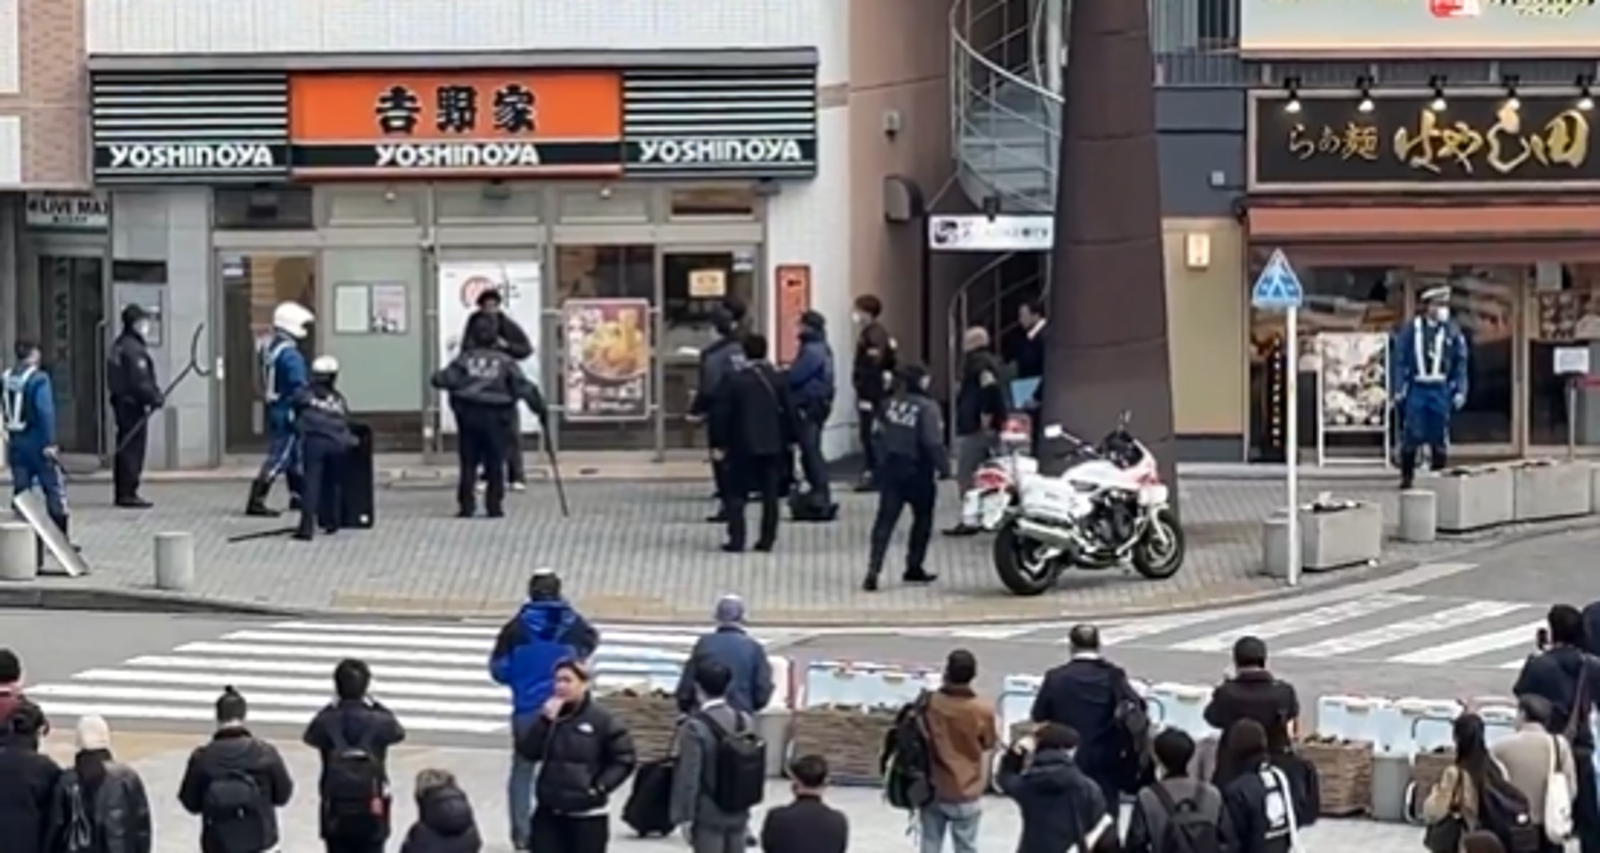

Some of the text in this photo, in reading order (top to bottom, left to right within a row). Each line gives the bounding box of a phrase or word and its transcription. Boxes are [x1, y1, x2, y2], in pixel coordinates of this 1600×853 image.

[377, 86, 535, 133] 吉野家
[638, 138, 802, 163] YOSHINOYA
[1393, 104, 1589, 173] はやし田
[109, 144, 275, 168] YOSHINOYA
[375, 144, 540, 167] YOSHINOYA
